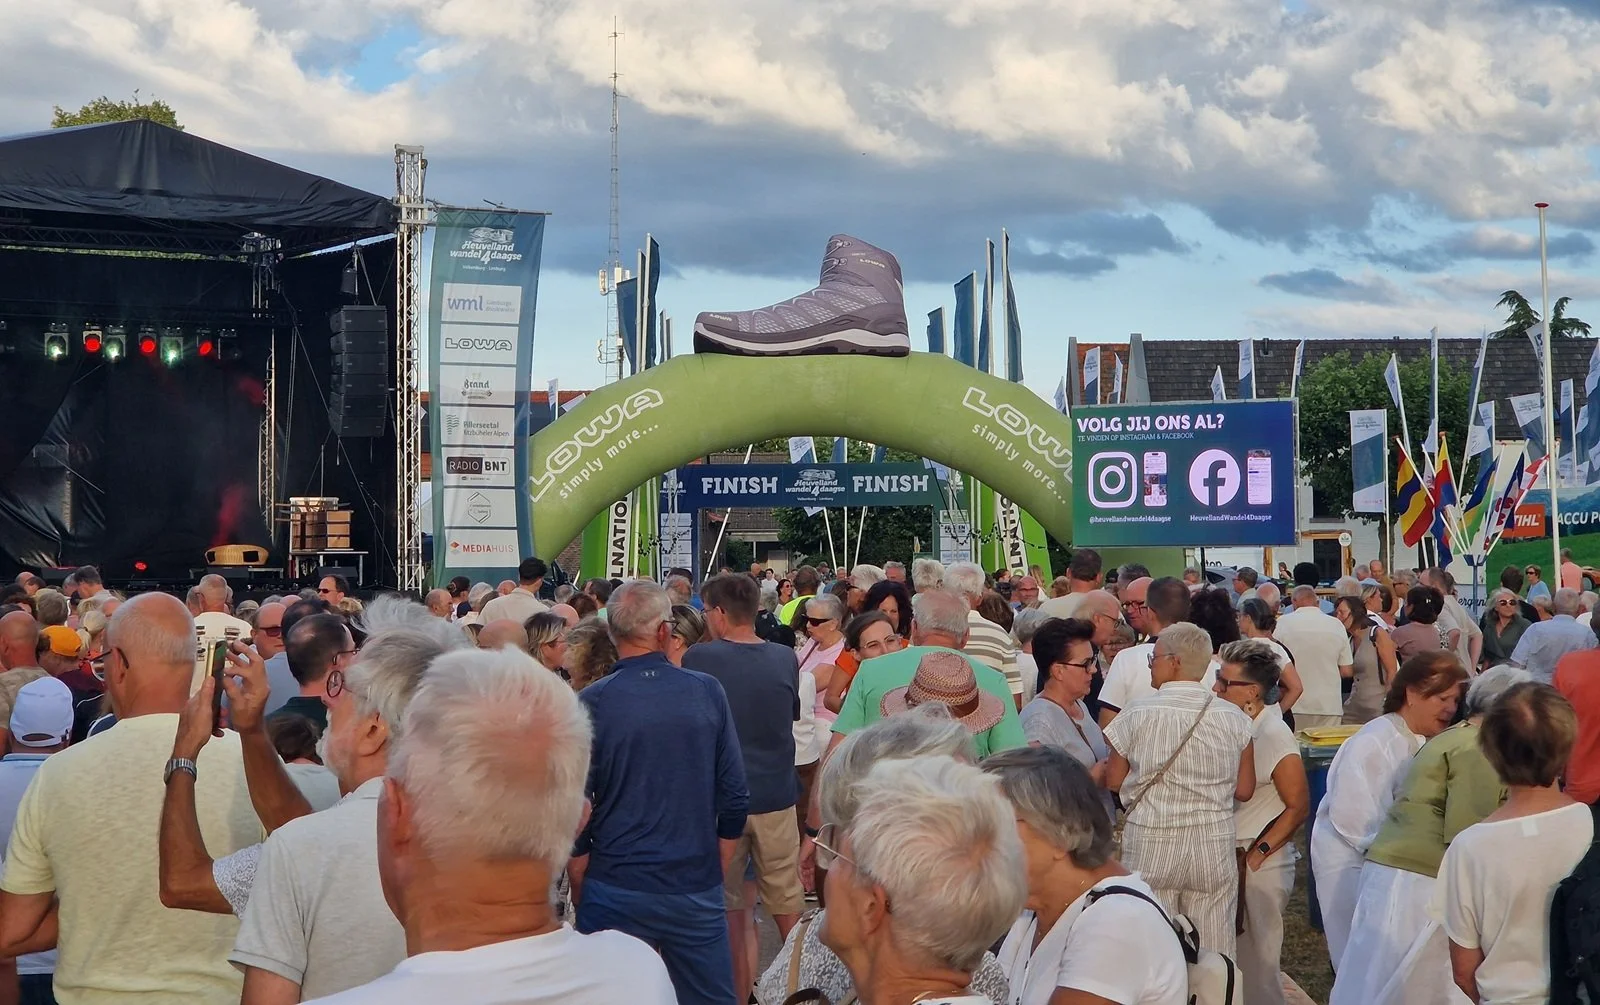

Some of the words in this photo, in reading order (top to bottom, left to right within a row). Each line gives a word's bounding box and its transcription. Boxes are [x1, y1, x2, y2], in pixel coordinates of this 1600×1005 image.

[461, 241, 514, 252] Heuvelland
[859, 258, 886, 269] LOWA
[447, 295, 484, 312] wml
[444, 338, 513, 351] LOWA
[463, 379, 490, 390] Brand
[1077, 416, 1123, 433] VOLG
[1126, 415, 1151, 432] JIJ
[1155, 414, 1191, 431] ONS
[1194, 413, 1225, 430] AL?
[962, 386, 1073, 484] LOW
[1086, 434, 1110, 442] VINDEN
[1120, 432, 1156, 441] INSTAGRAM
[1161, 431, 1195, 440] FACEBOOK
[529, 388, 665, 504] LOWA
[971, 422, 1020, 462] simply
[449, 461, 480, 471] RADIO
[484, 461, 507, 472] BNT
[559, 457, 604, 500] simply
[701, 476, 778, 494] FINISH
[794, 479, 838, 487] Heuvelland
[852, 474, 929, 493] FINISH
[1089, 515, 1172, 524] @heuvellandwandel4daagse
[1189, 513, 1273, 522] HeuvellandWandel4Daagse
[1514, 514, 1540, 527] TIHL
[1557, 511, 1589, 525] ACCU
[1591, 511, 1600, 524] P
[462, 544, 514, 553] MEDIAHUIS
